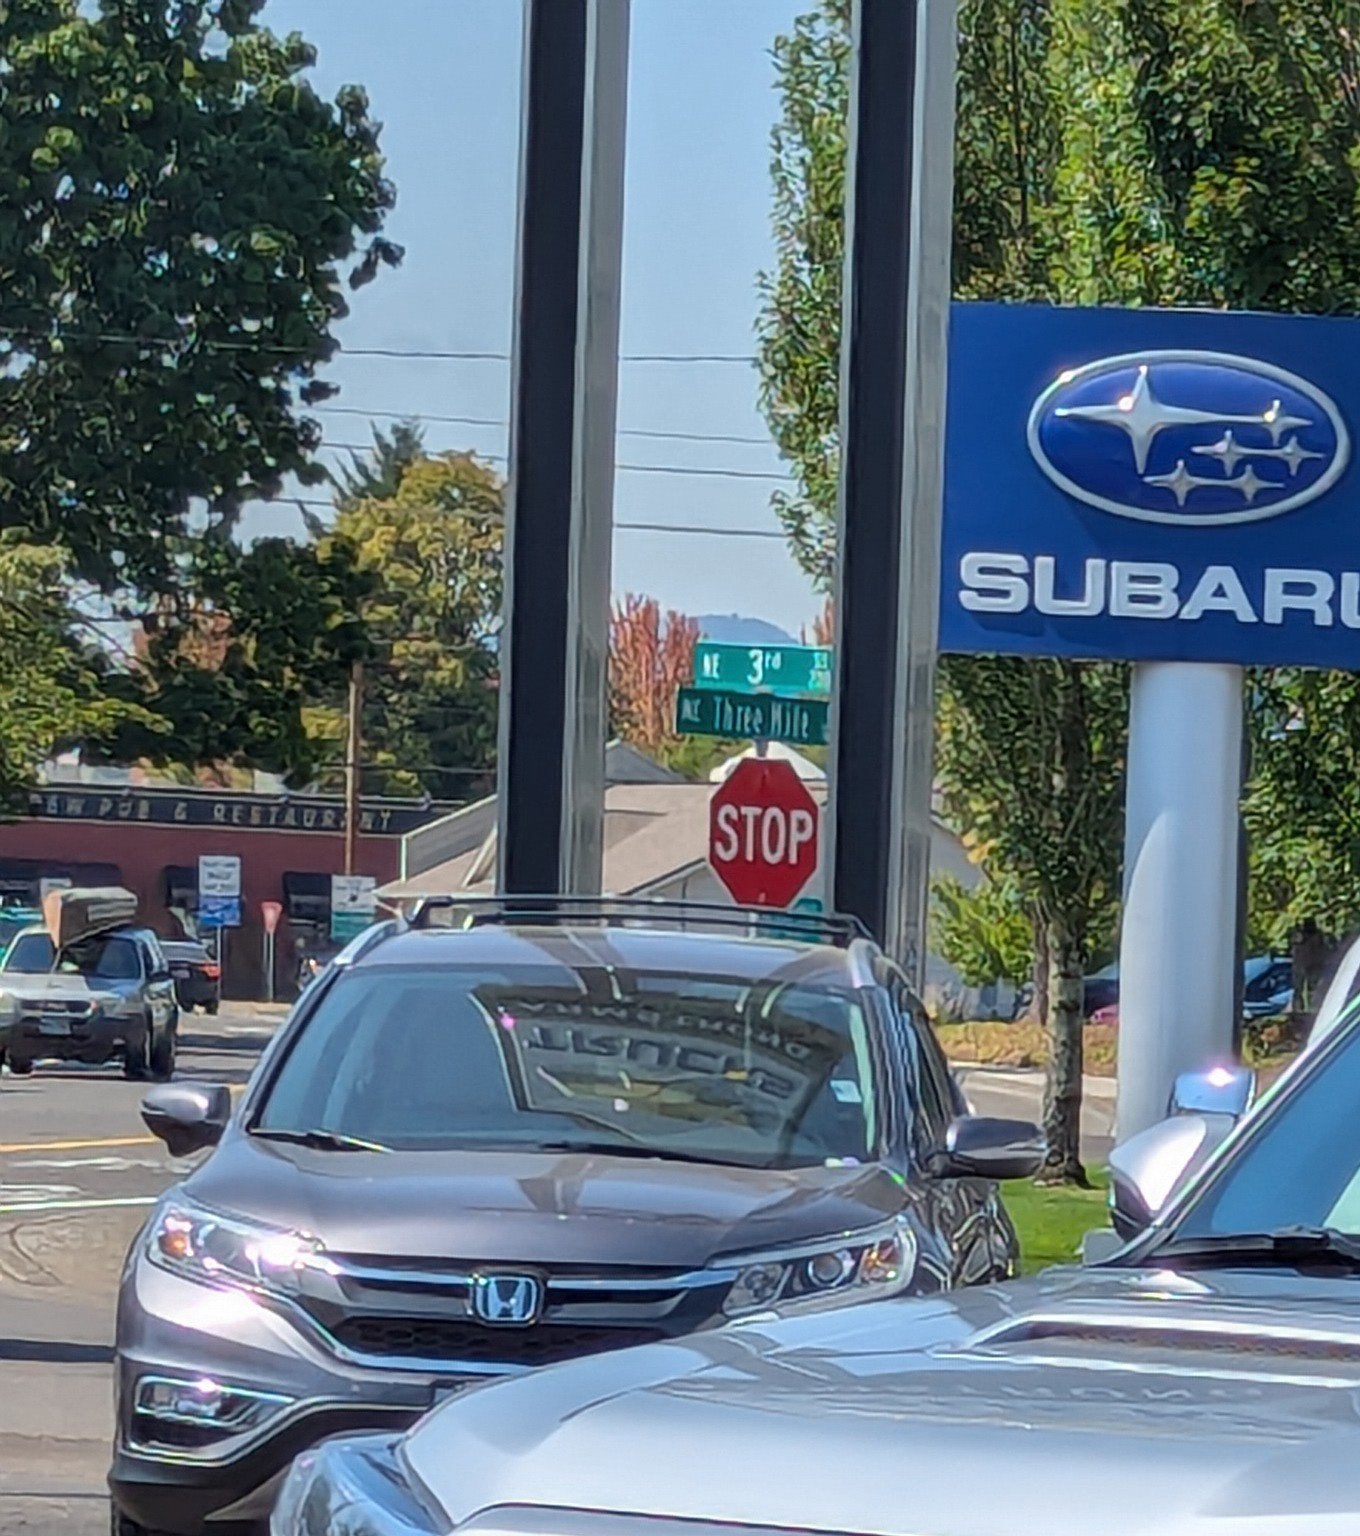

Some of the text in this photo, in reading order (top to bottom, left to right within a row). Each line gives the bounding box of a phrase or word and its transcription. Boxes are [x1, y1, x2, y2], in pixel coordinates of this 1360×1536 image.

[702, 653, 720, 679] NE
[747, 649, 782, 685] 3rd
[213, 803, 391, 832] RESTAURNT
[715, 804, 813, 864] STOP
